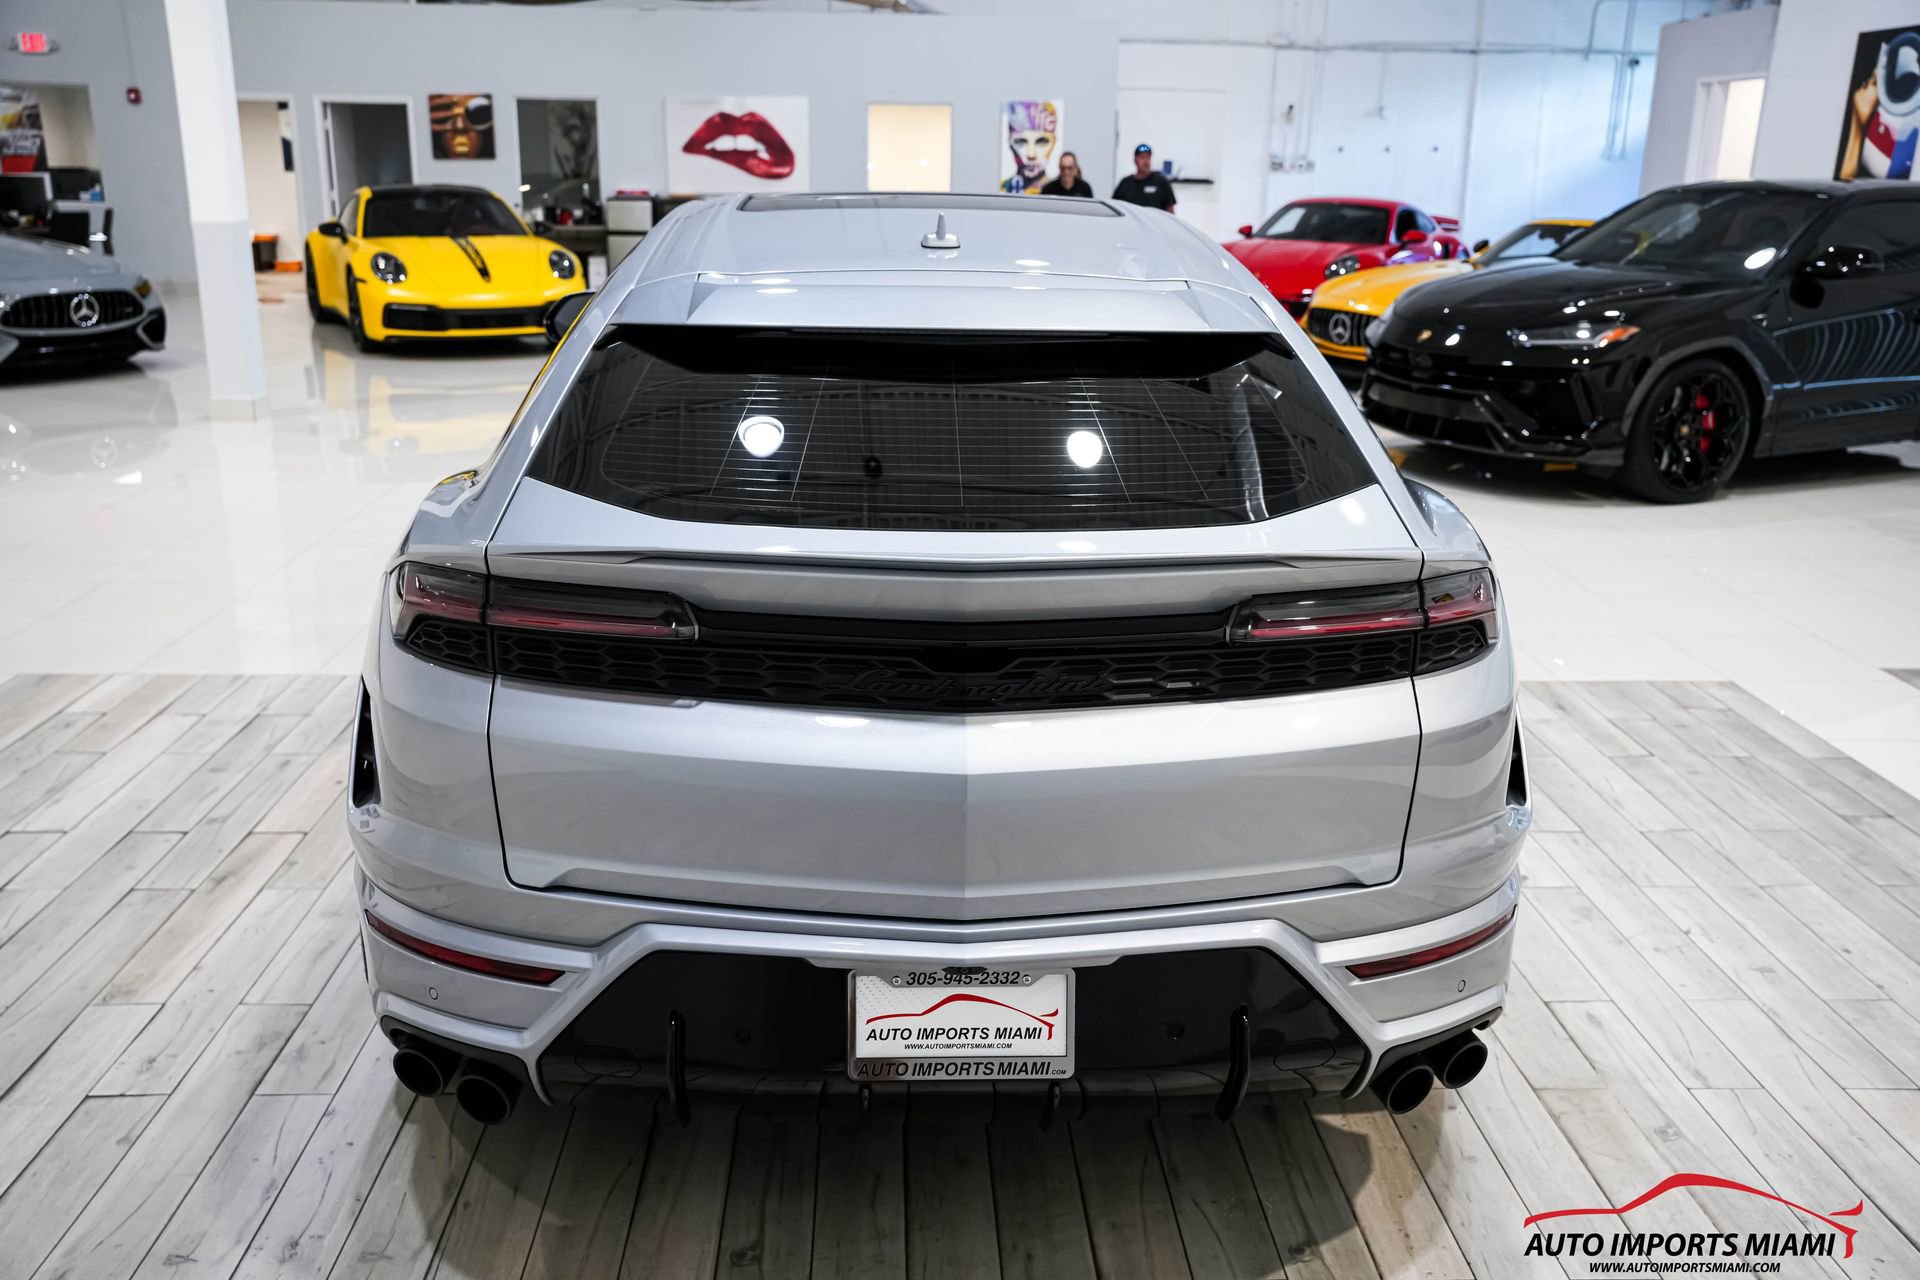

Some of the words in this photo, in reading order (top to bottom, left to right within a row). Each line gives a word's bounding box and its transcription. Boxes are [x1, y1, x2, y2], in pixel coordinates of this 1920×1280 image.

[906, 971, 1021, 985] 305-945-2332
[866, 1028, 912, 1042] AUTO
[916, 1027, 990, 1041] IMPORTS
[994, 1027, 1043, 1041] MIAMI
[857, 1062, 910, 1077] AUTO
[911, 1062, 995, 1077] IMPORTS
